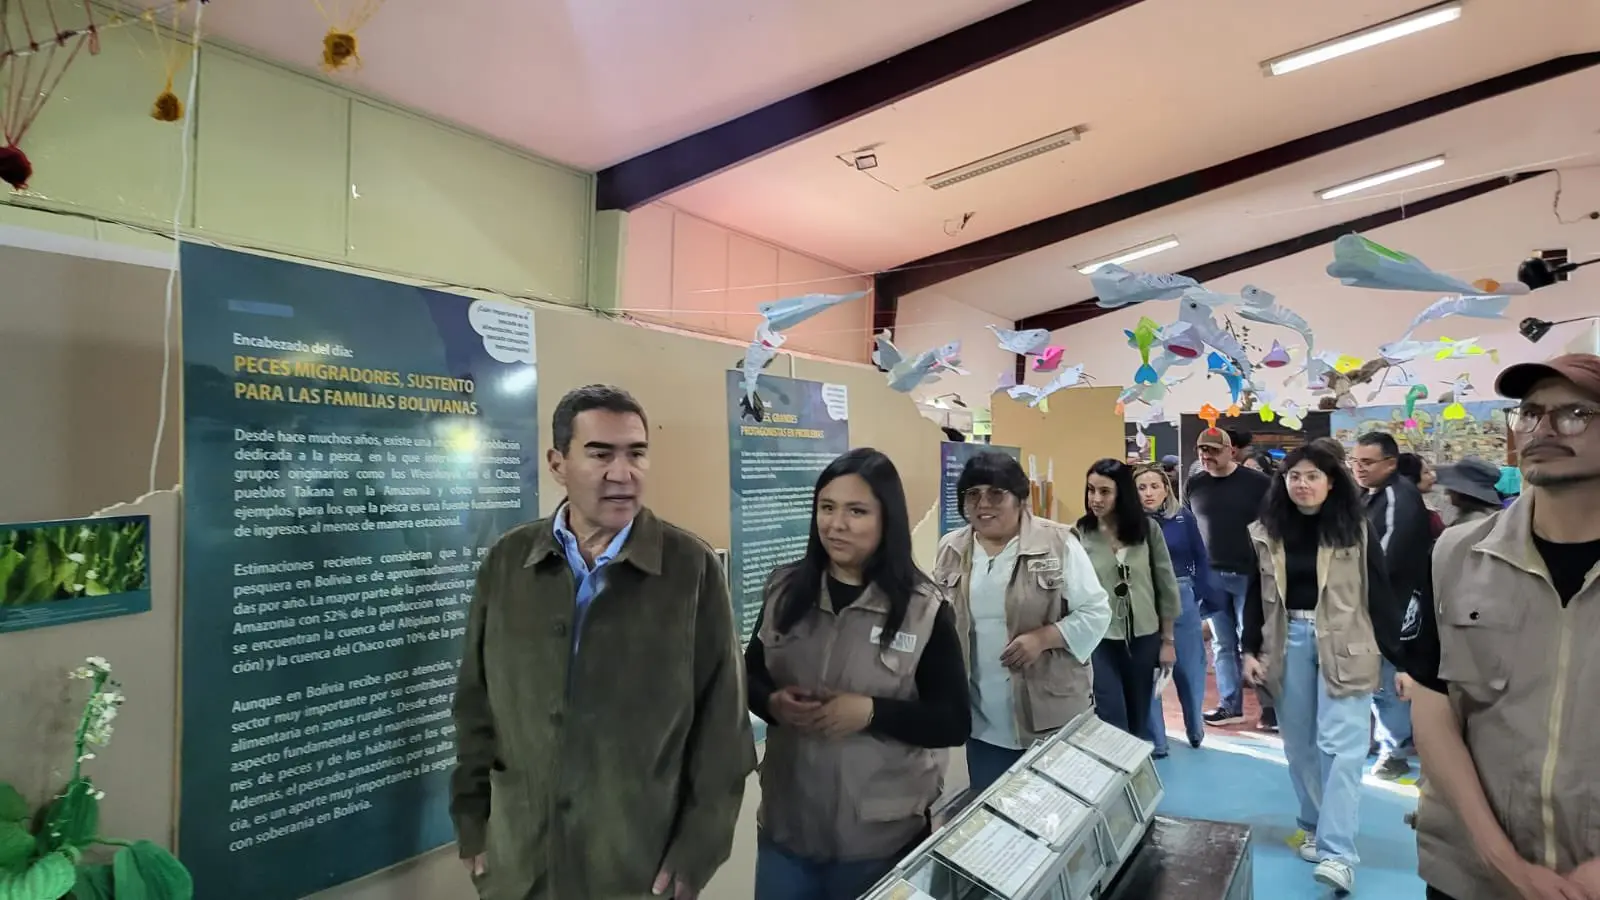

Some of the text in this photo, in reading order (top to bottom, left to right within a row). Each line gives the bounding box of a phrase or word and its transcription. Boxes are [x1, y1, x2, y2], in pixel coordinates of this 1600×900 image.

[233, 333, 353, 358] Encabezado del día:
[233, 356, 474, 393] PECES MIGRADORES, SUSTENTO
[234, 383, 477, 415] PARA LAS FAMILIAS BOLIVIANAS
[234, 429, 275, 441] Desde
[277, 431, 306, 443] hace
[308, 433, 352, 444] muchos
[354, 434, 382, 446] años,
[384, 436, 412, 446] existe
[414, 438, 431, 447] una
[234, 449, 292, 460] dedicada
[312, 450, 323, 461] la
[329, 453, 363, 464] pesca,
[369, 453, 382, 462] en
[387, 452, 396, 462] la
[402, 455, 420, 465] que
[234, 468, 520, 481] grupos originarios como los el Chaco,
[234, 486, 286, 500] pueblos
[293, 486, 334, 496] Takana
[344, 488, 357, 496] en
[365, 485, 375, 496] la
[384, 486, 430, 495] Amazonía
[438, 488, 444, 497] y
[234, 499, 520, 520] ejemplos, para los que la pesca es una fuente fundamental
[234, 516, 461, 538] de ingresos, al menos de manera estacional.
[234, 550, 456, 576] Estimaciones recientes consideran que
[233, 582, 292, 599] pesquera
[296, 580, 311, 589] en
[315, 573, 352, 587] Bolivia
[370, 570, 384, 581] de
[386, 564, 469, 581] aproximadamente
[233, 603, 256, 615] das
[258, 601, 280, 615] por
[282, 597, 308, 609] año.
[310, 595, 323, 606] La
[326, 593, 360, 604] mayor
[362, 589, 389, 602] parte
[391, 585, 404, 596] de
[405, 584, 414, 594] la
[415, 579, 465, 595] producción
[232, 644, 248, 654] se
[252, 633, 320, 651] encuentran
[324, 629, 334, 640] la
[338, 625, 375, 638] cuenca
[378, 620, 394, 631] del
[398, 615, 440, 628] Altiplano
[233, 616, 296, 634] Amazonía
[299, 615, 320, 625] con
[323, 609, 348, 622] 52%
[351, 607, 365, 619] de
[368, 606, 377, 616] la
[380, 600, 433, 617] producción
[232, 658, 264, 673] ción)
[266, 659, 274, 671] y
[277, 654, 288, 666] la
[290, 650, 331, 664] cuenca
[333, 643, 350, 657] del
[352, 640, 384, 653] Chaco
[386, 637, 404, 648] con
[407, 633, 426, 644] 10%
[428, 630, 440, 640] de
[441, 628, 449, 638] la
[231, 674, 457, 733] sector muy importante por su contribució
[232, 695, 282, 713] Aunque
[286, 691, 302, 702] en
[306, 682, 344, 698] Bolivia
[349, 674, 381, 689] recibe
[385, 670, 409, 684] poca
[412, 661, 453, 676] atención,
[230, 727, 301, 752] alimentaria
[304, 725, 319, 735] en
[322, 716, 354, 731] zonas
[357, 707, 395, 722] rurales.
[397, 699, 427, 712] Desde
[428, 694, 448, 705] este
[230, 708, 452, 772] aspecto fundamental es el mantenimient
[230, 779, 253, 792] nes
[258, 772, 274, 784] de
[278, 763, 312, 782] peces
[316, 760, 324, 772] y
[327, 754, 342, 766] de
[346, 750, 362, 760] los
[365, 737, 406, 756] hábitats
[409, 734, 422, 744] en
[424, 728, 438, 739] los
[229, 818, 251, 832] cia,
[254, 814, 268, 824] es
[270, 807, 287, 819] un
[288, 795, 328, 815] aporte
[329, 788, 354, 801] muy
[355, 770, 412, 794] importante
[421, 763, 430, 773] la
[230, 790, 284, 812] Además,
[285, 783, 297, 796] el
[298, 771, 346, 795] pescado
[406, 750, 423, 764] por
[424, 747, 435, 756] su
[229, 800, 372, 852] con soberanía en Bolivia.
